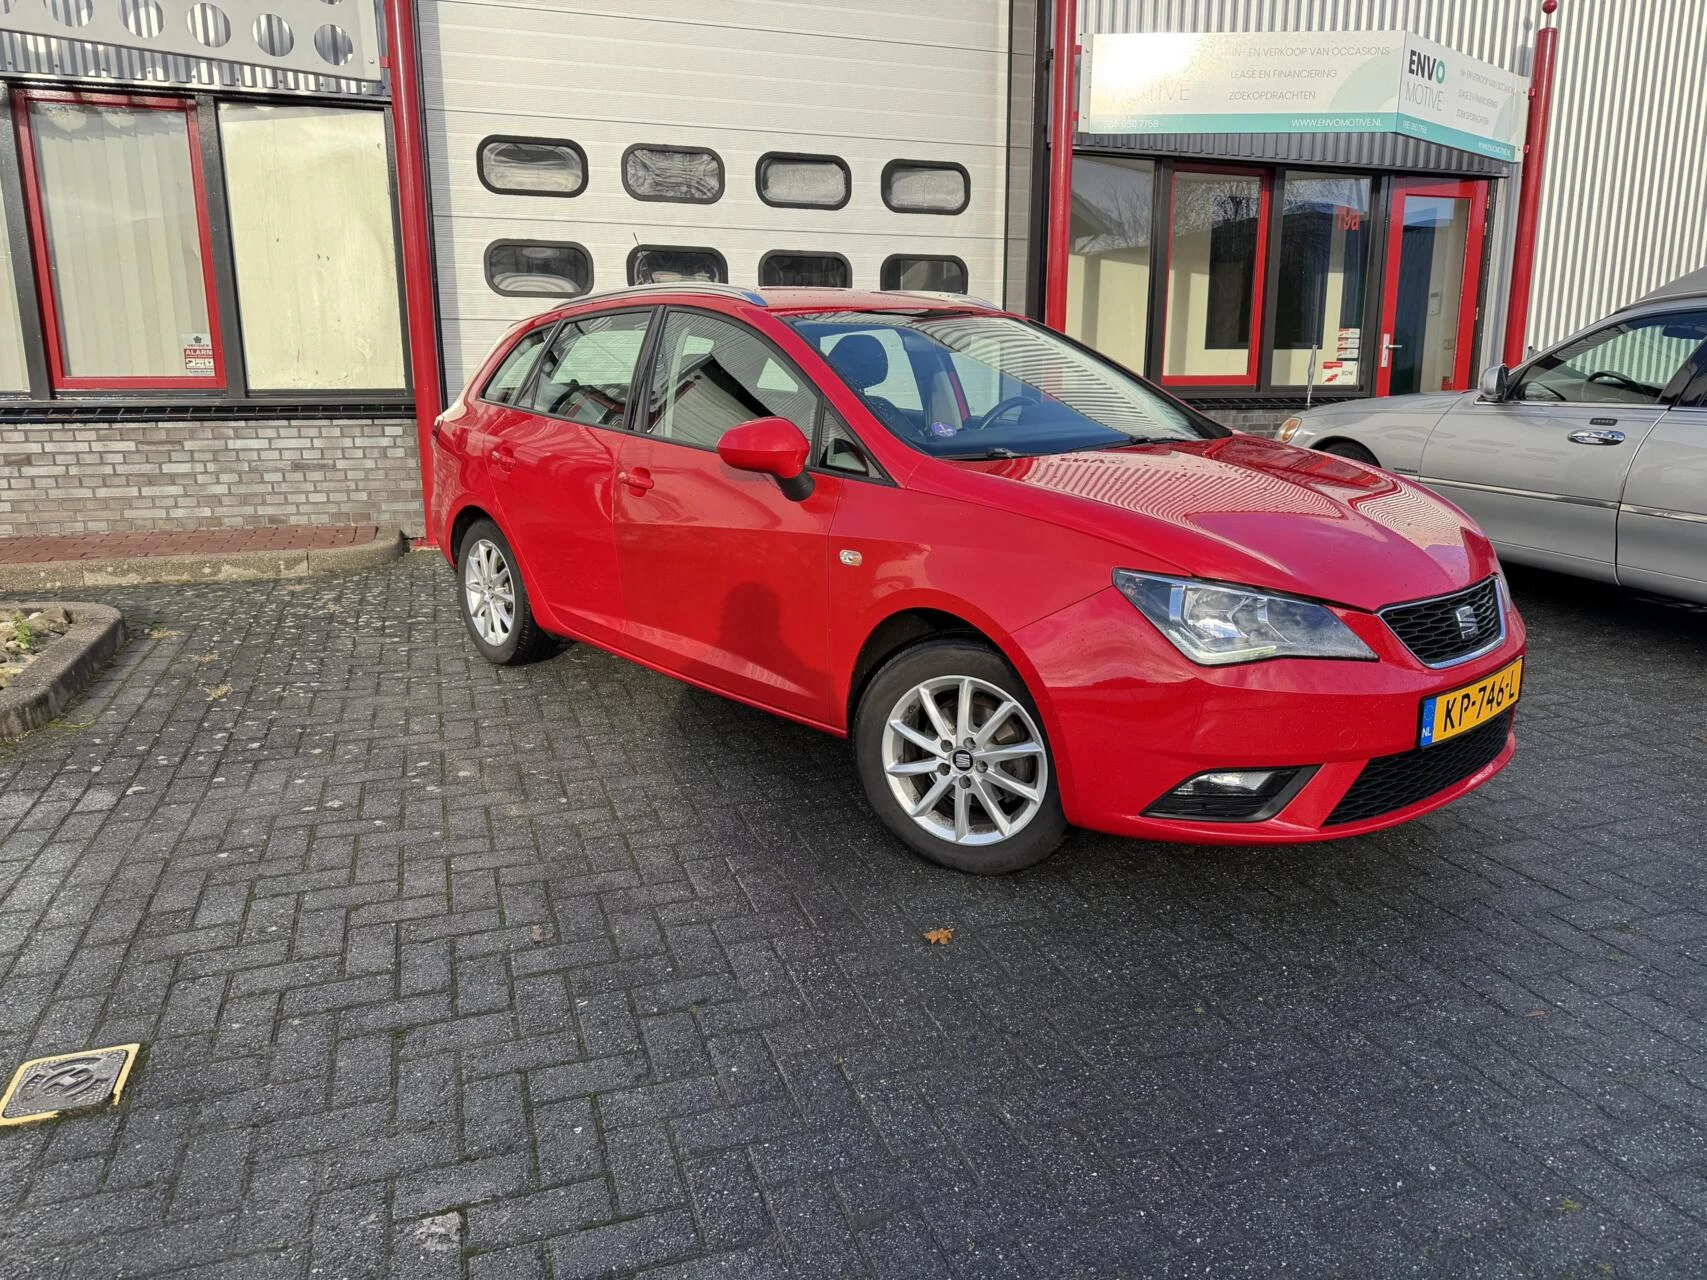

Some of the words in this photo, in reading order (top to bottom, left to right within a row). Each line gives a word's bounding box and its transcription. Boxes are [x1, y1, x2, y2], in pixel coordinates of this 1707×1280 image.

[1248, 47, 1261, 57] EN
[1263, 47, 1307, 57] VERKOOP
[1309, 46, 1330, 57] VAN
[1331, 46, 1390, 57] OCCASIONS
[1408, 49, 1446, 84] ENVO
[1231, 69, 1257, 79] LEASE
[1259, 69, 1271, 79] EN
[1273, 68, 1337, 79] FINANCIERING
[1228, 90, 1316, 101] ZOEKOPDRACHTEN
[1405, 81, 1444, 112] MOTIVE
[1291, 118, 1382, 128] WWW.ENVOMOTIVE.NL
[1443, 670, 1515, 733] KP-746-L
[1422, 727, 1431, 738] NL
